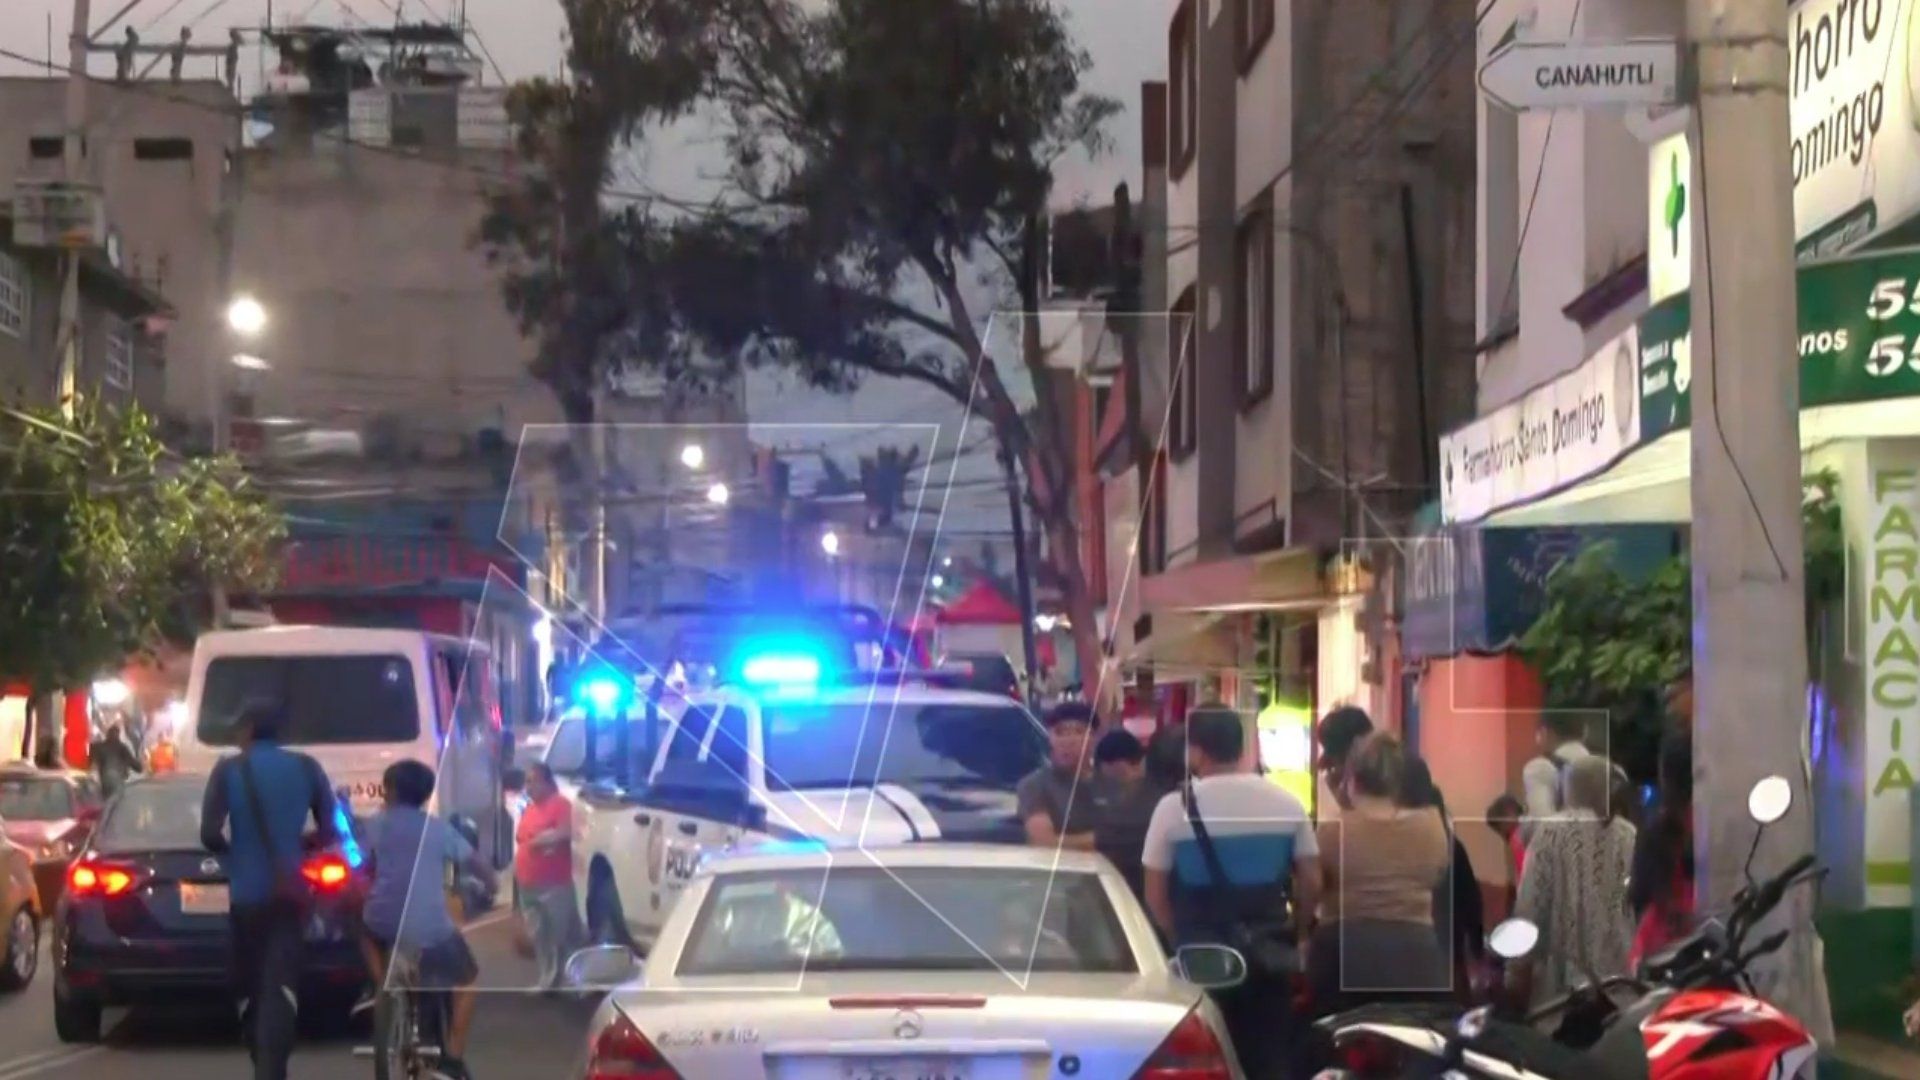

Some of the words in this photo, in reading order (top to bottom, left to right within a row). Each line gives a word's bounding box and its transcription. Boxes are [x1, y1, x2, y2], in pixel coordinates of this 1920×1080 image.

[1535, 61, 1654, 89] CANAHUTLI
[1797, 328, 1849, 357] nos
[1516, 417, 1549, 465] Santo
[1551, 391, 1606, 456] Domingo
[1871, 470, 1920, 797] FARMACIA
